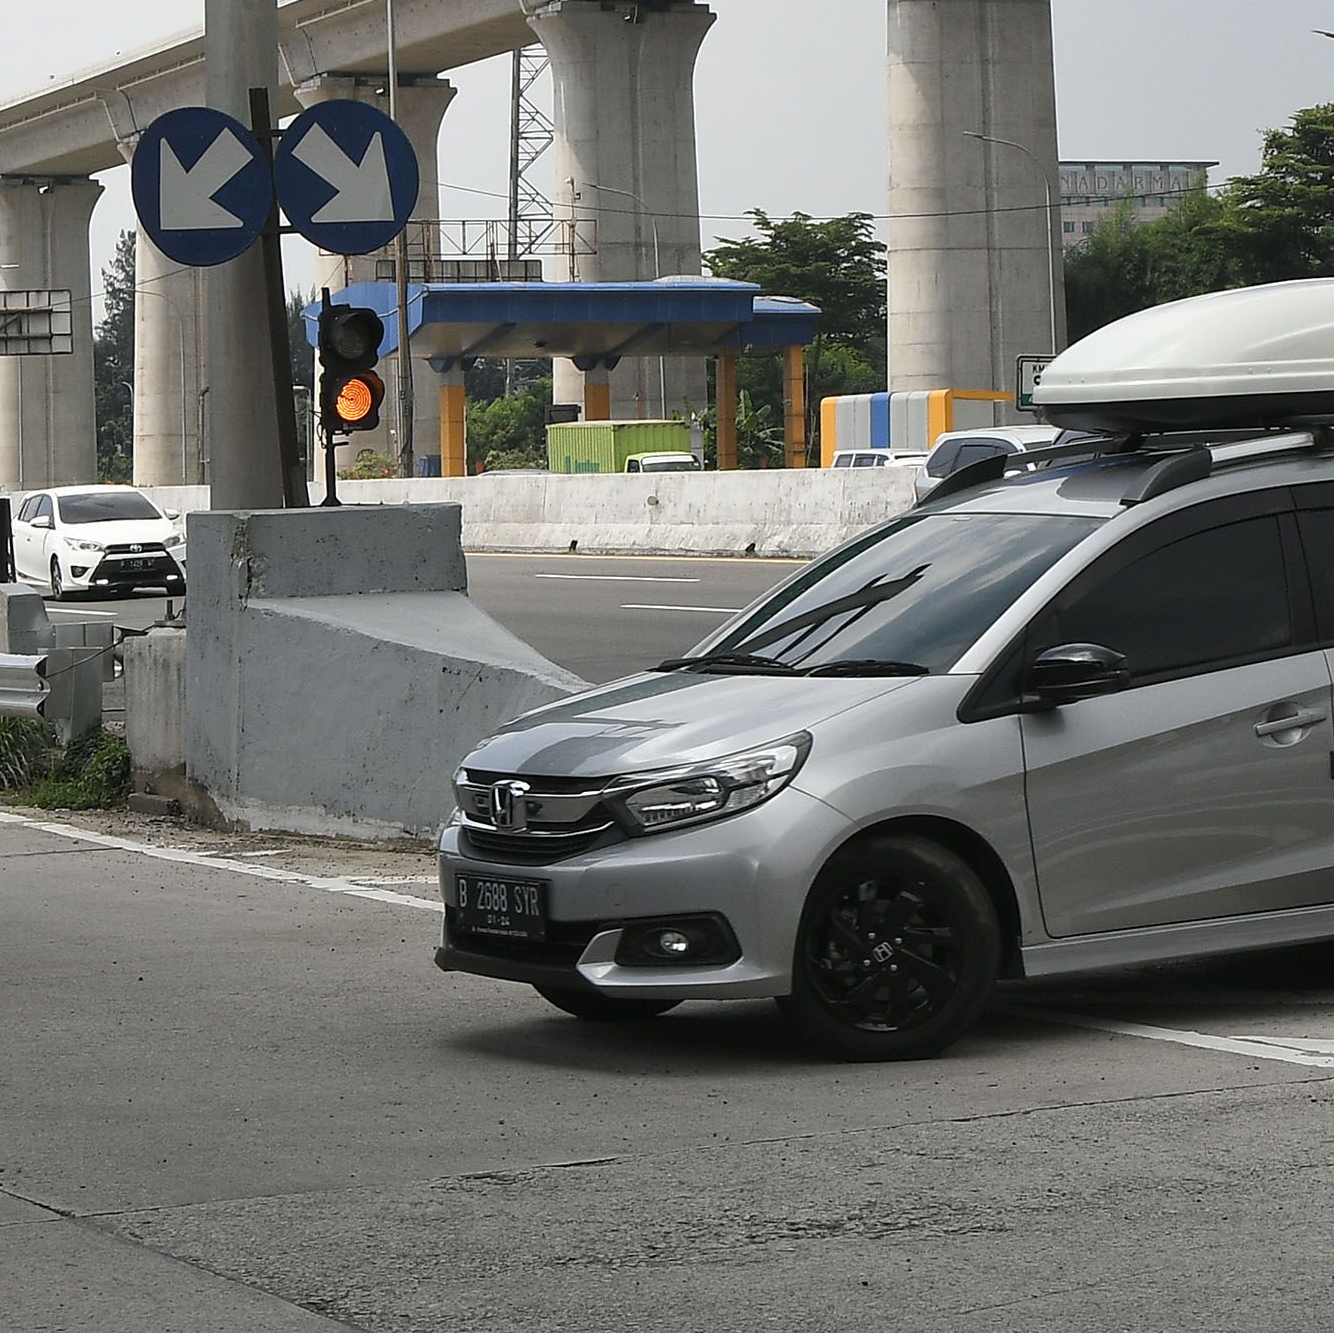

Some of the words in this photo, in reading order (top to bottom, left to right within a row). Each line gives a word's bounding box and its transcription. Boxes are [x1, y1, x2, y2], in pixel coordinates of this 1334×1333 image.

[459, 879, 468, 908] B
[476, 881, 508, 913] 2688
[513, 885, 540, 916] SYR
